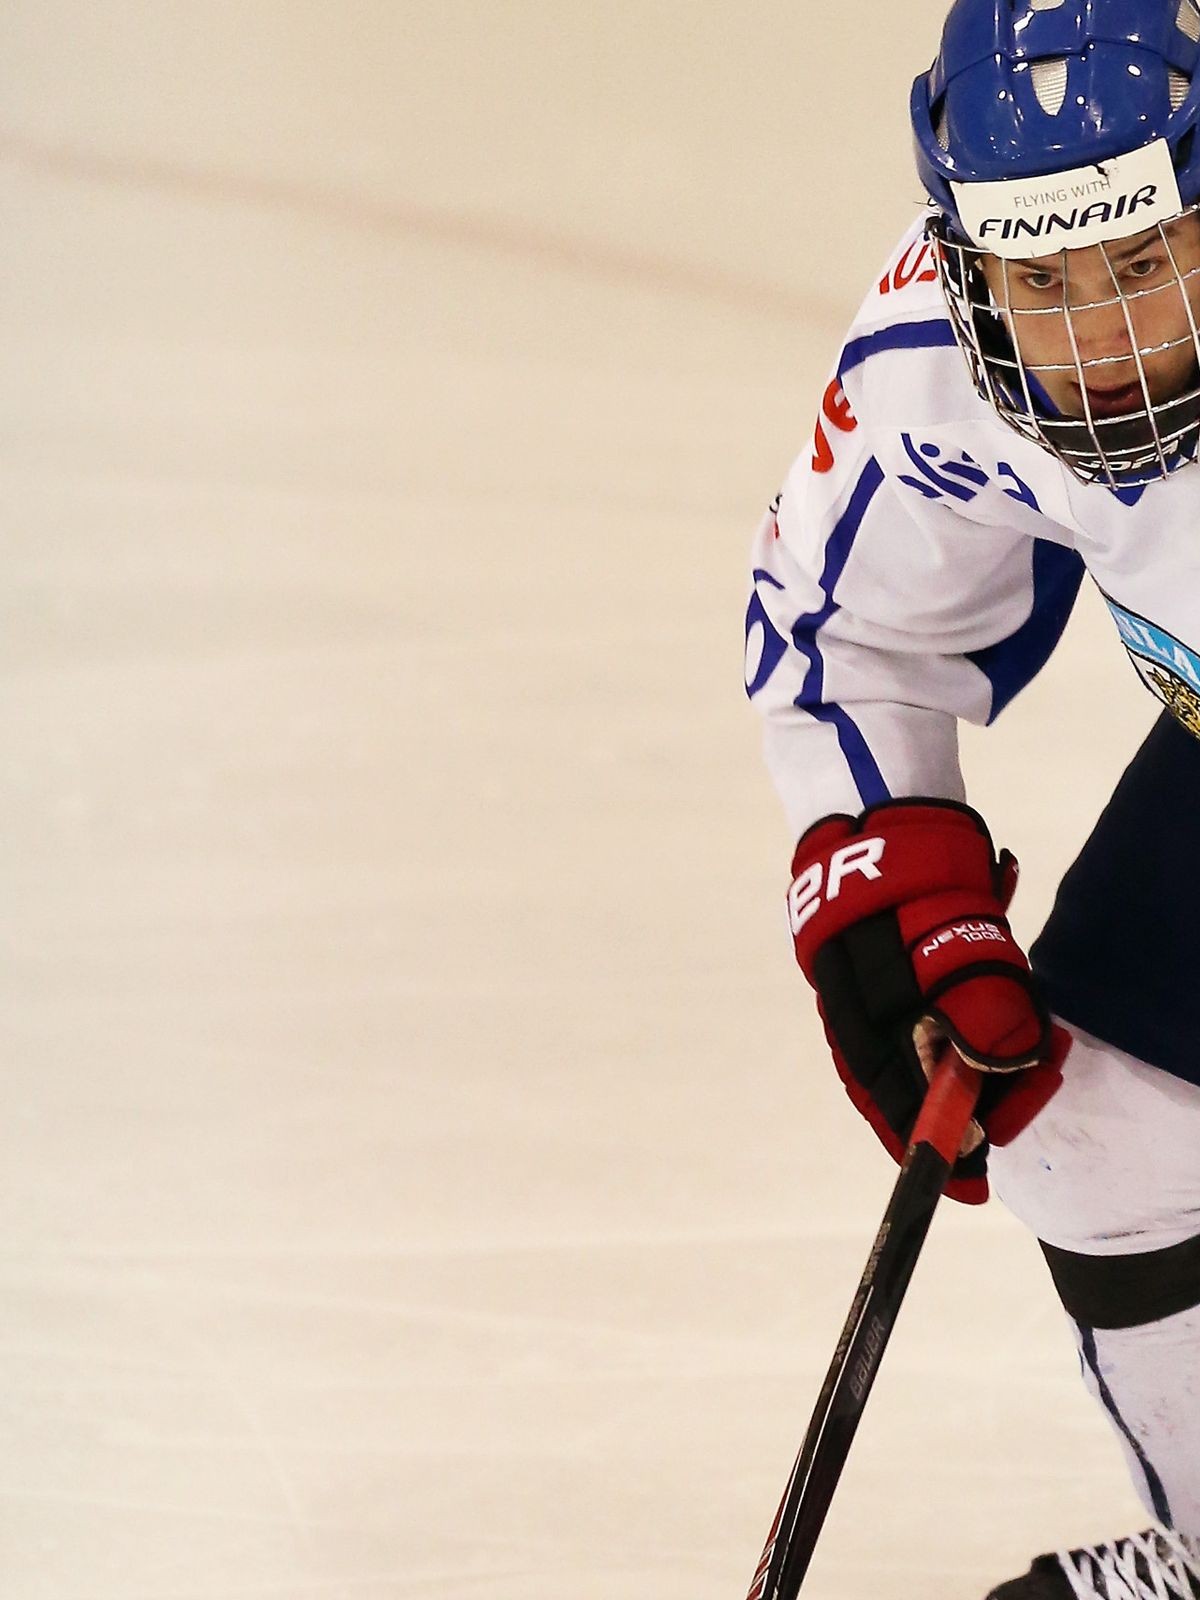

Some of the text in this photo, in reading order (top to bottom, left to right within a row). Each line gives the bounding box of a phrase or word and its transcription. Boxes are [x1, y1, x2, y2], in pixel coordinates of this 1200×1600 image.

[1014, 177, 1112, 209] FLYING WITH
[978, 184, 1157, 240] FINNAIR
[922, 922, 1001, 957] NEXUS
[961, 931, 1007, 943] 1000
